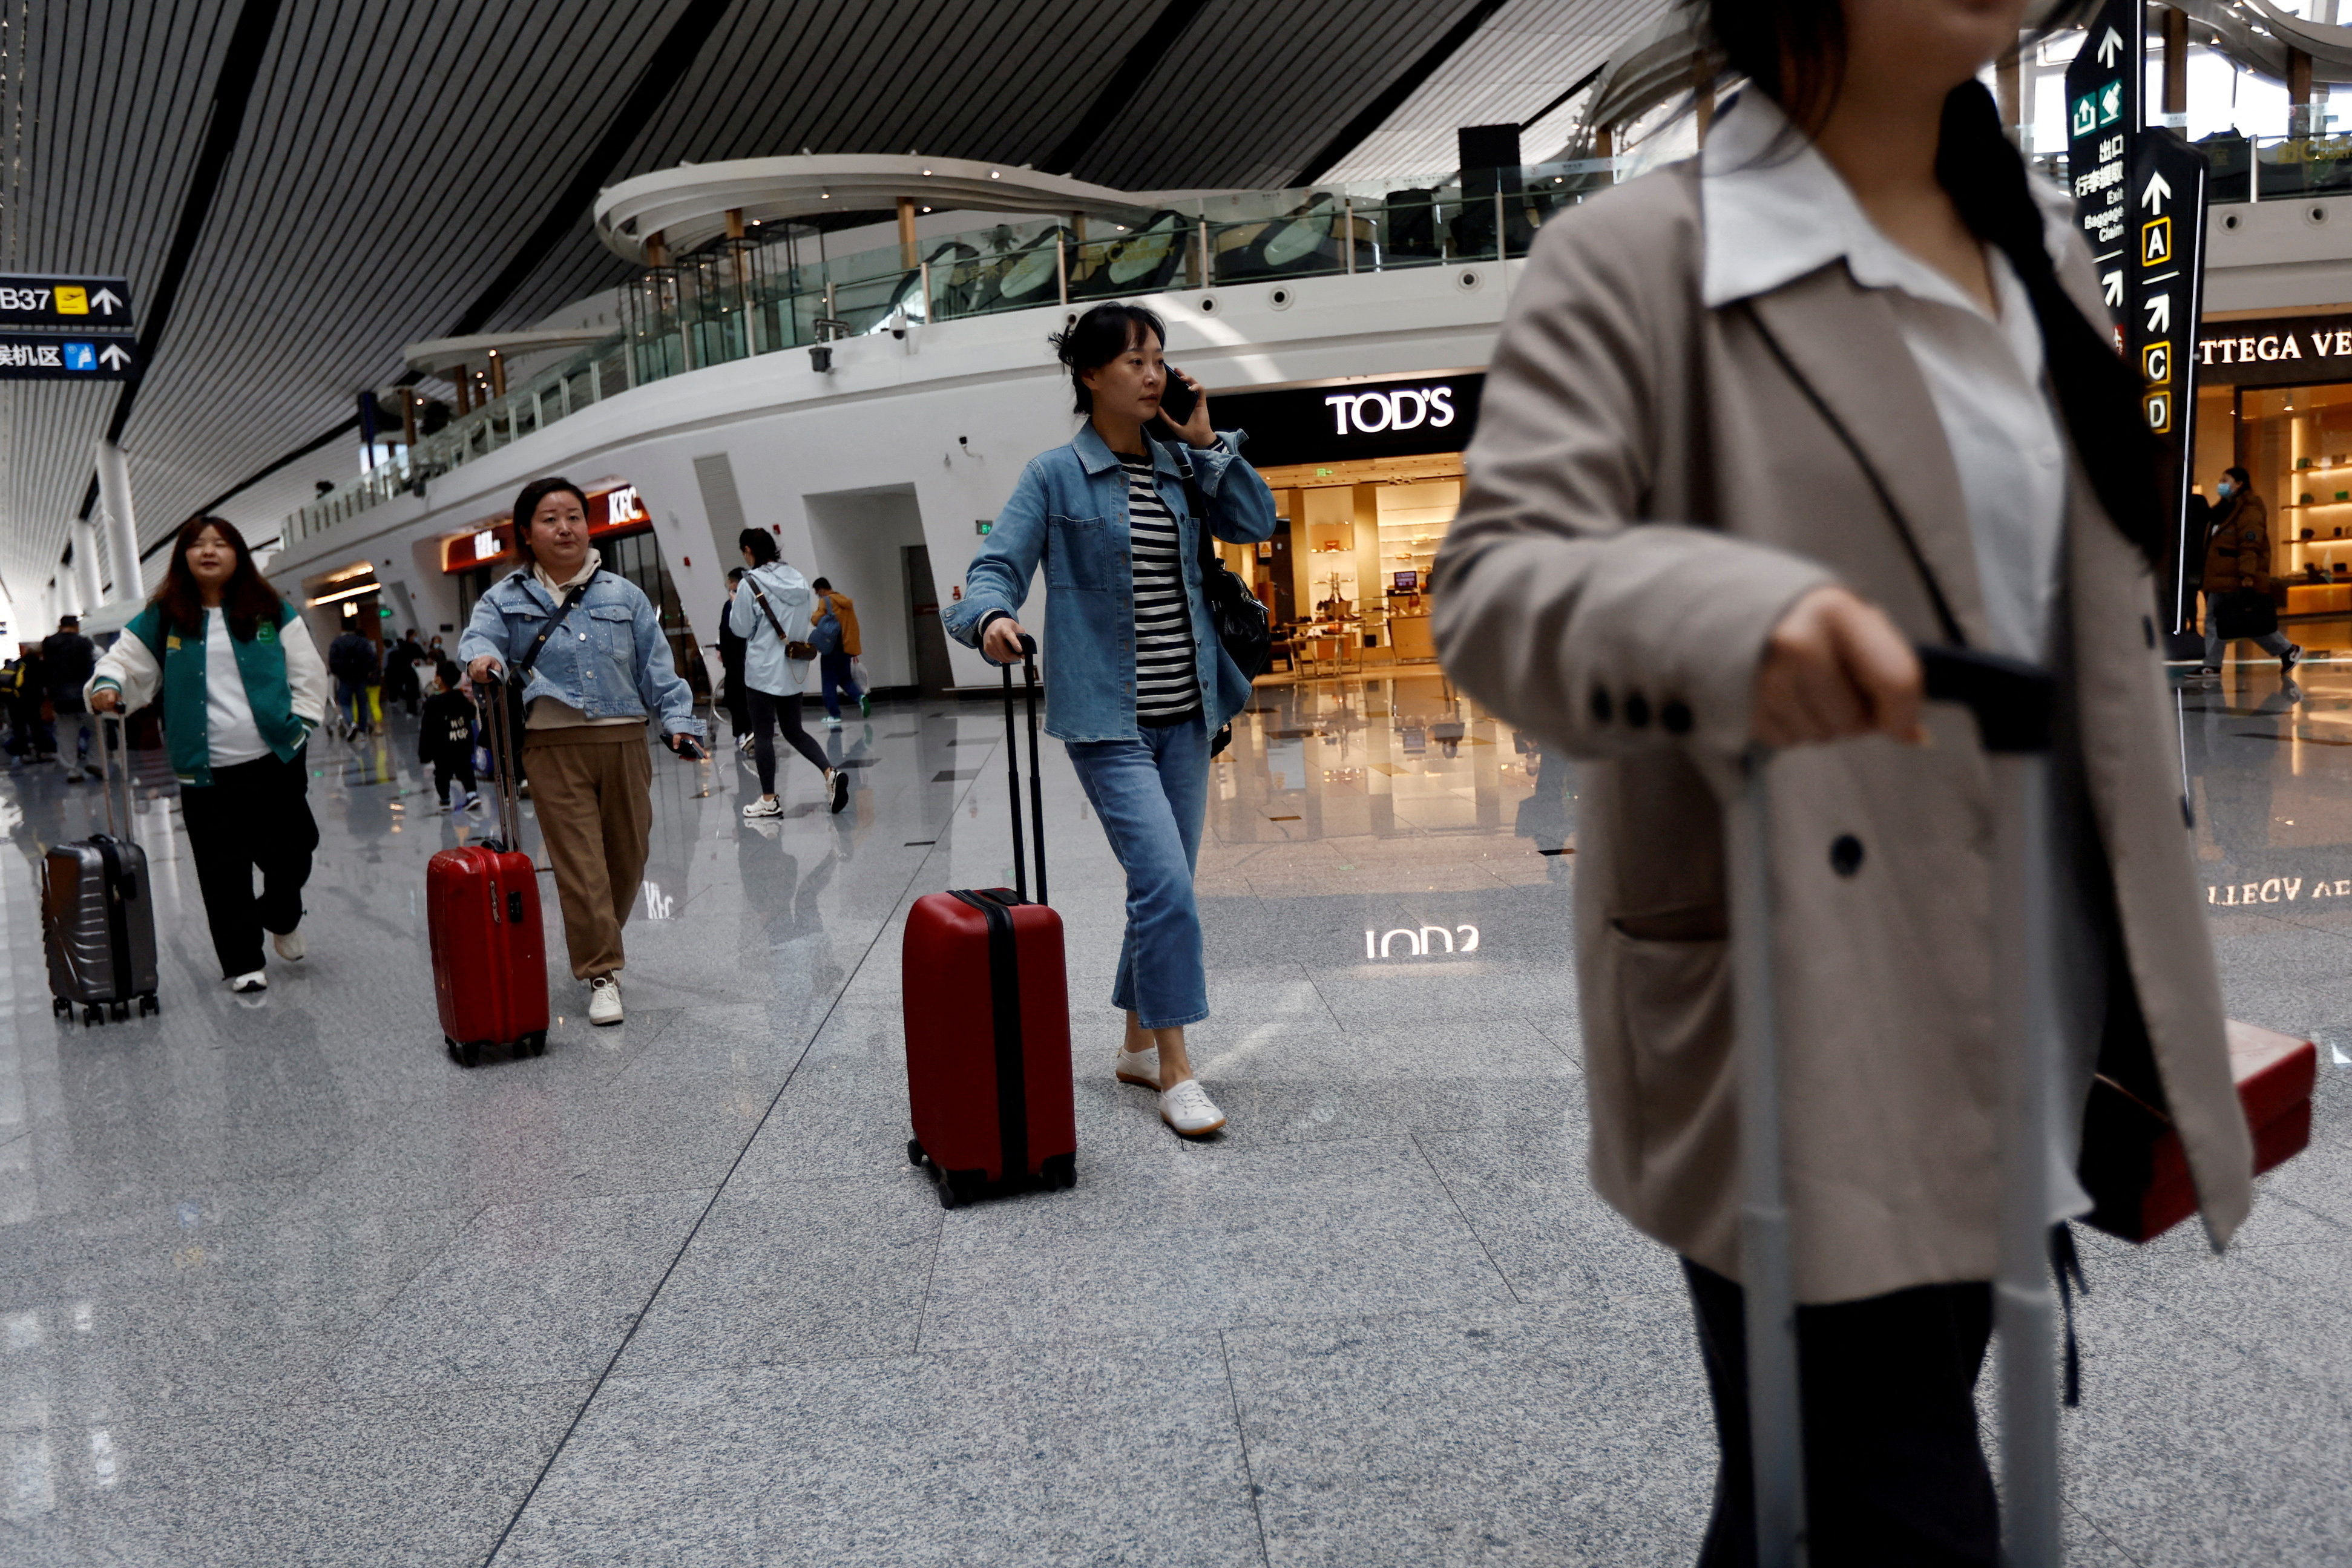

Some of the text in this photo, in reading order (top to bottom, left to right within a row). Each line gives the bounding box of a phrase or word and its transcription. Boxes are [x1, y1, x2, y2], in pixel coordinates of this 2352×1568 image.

[2099, 134, 2124, 163] 出口
[2075, 160, 2124, 198] 行李提取
[2106, 186, 2124, 205] Exit
[2084, 205, 2124, 229] Baggage
[2099, 223, 2124, 242] Claim
[2147, 226, 2166, 259] A
[0, 287, 51, 310] B37
[2148, 349, 2166, 380] C
[2199, 334, 2302, 365] TTEGA
[1325, 387, 1454, 435] TOD'S
[2149, 398, 2166, 428] D
[608, 485, 639, 525] KFC
